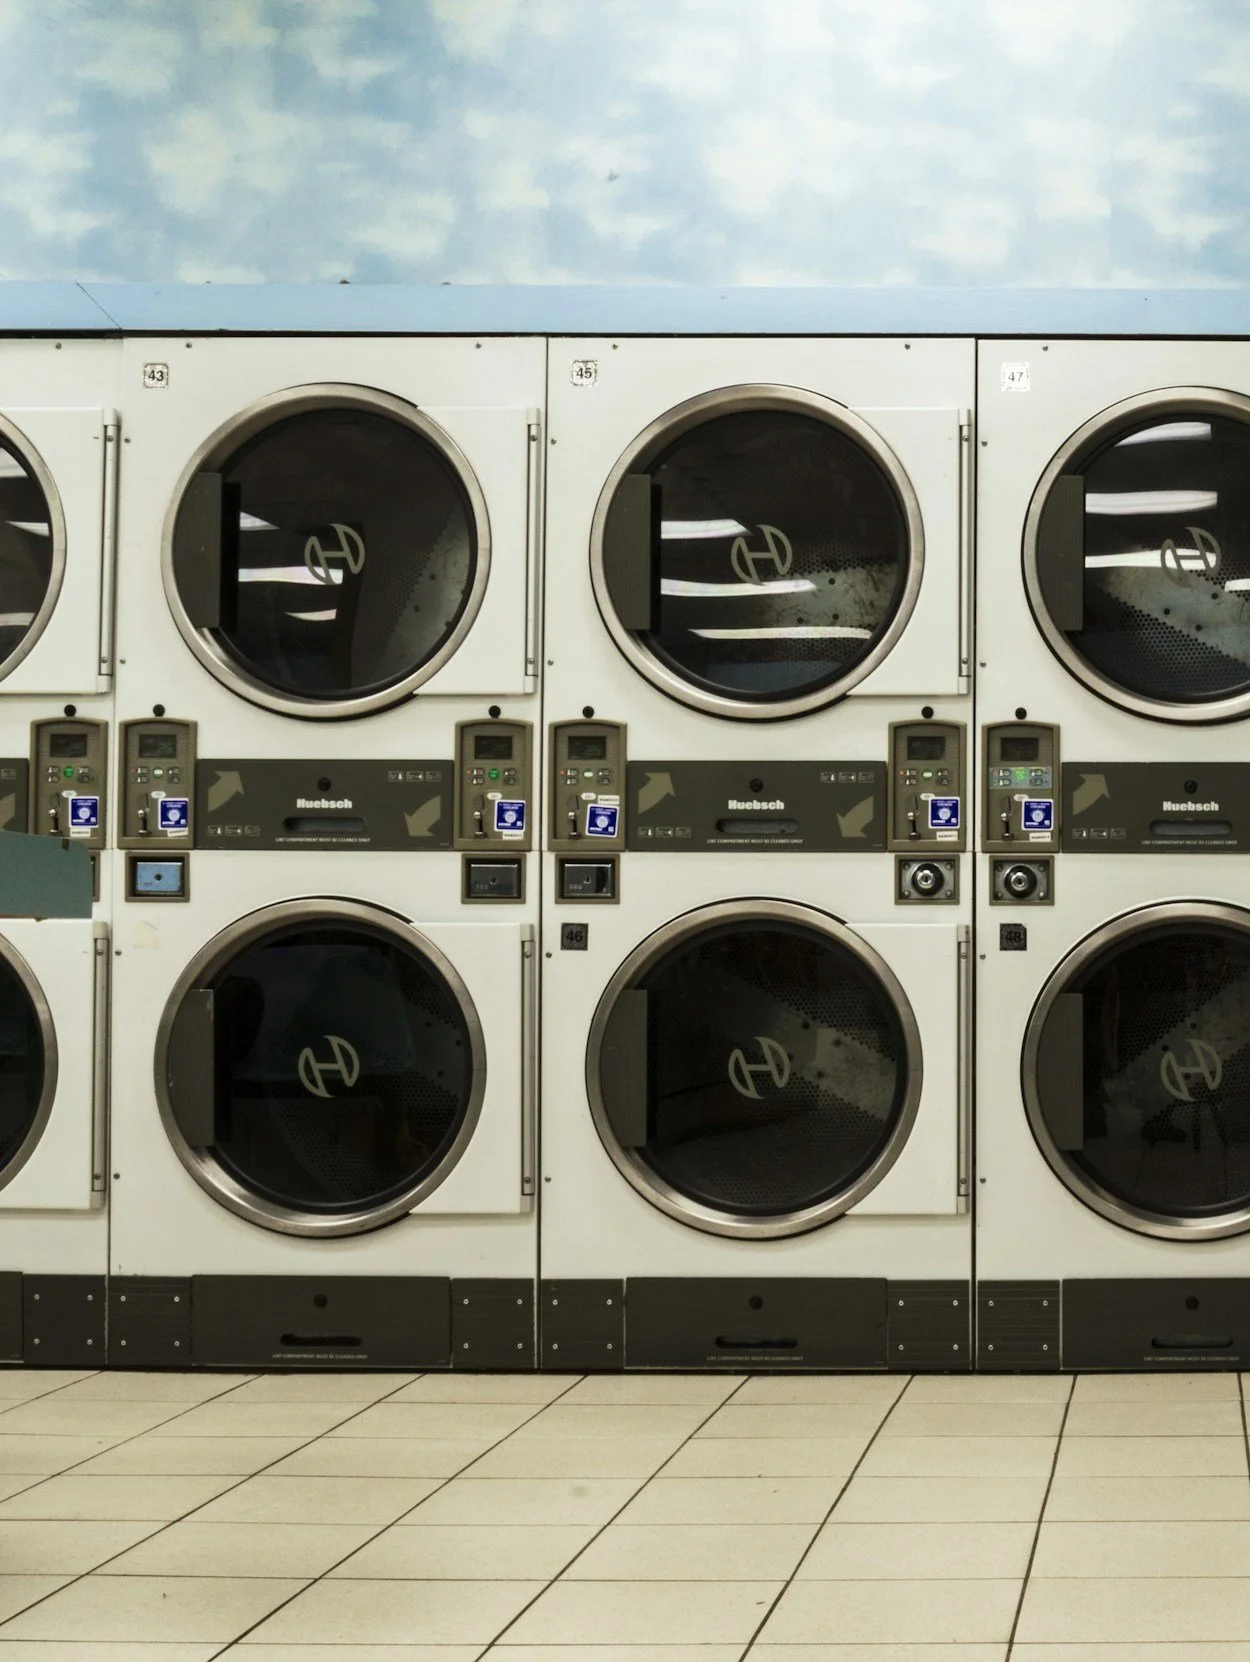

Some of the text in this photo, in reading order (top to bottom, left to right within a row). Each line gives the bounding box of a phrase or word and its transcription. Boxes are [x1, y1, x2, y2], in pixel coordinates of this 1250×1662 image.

[148, 369, 164, 382] 43
[576, 367, 592, 379] 45
[1007, 371, 1024, 383] 47
[296, 798, 353, 809] Huebsch
[727, 799, 785, 810] Huebsch
[1162, 801, 1220, 811] Huebsch
[566, 931, 583, 943] 46
[1005, 931, 1022, 943] 48
